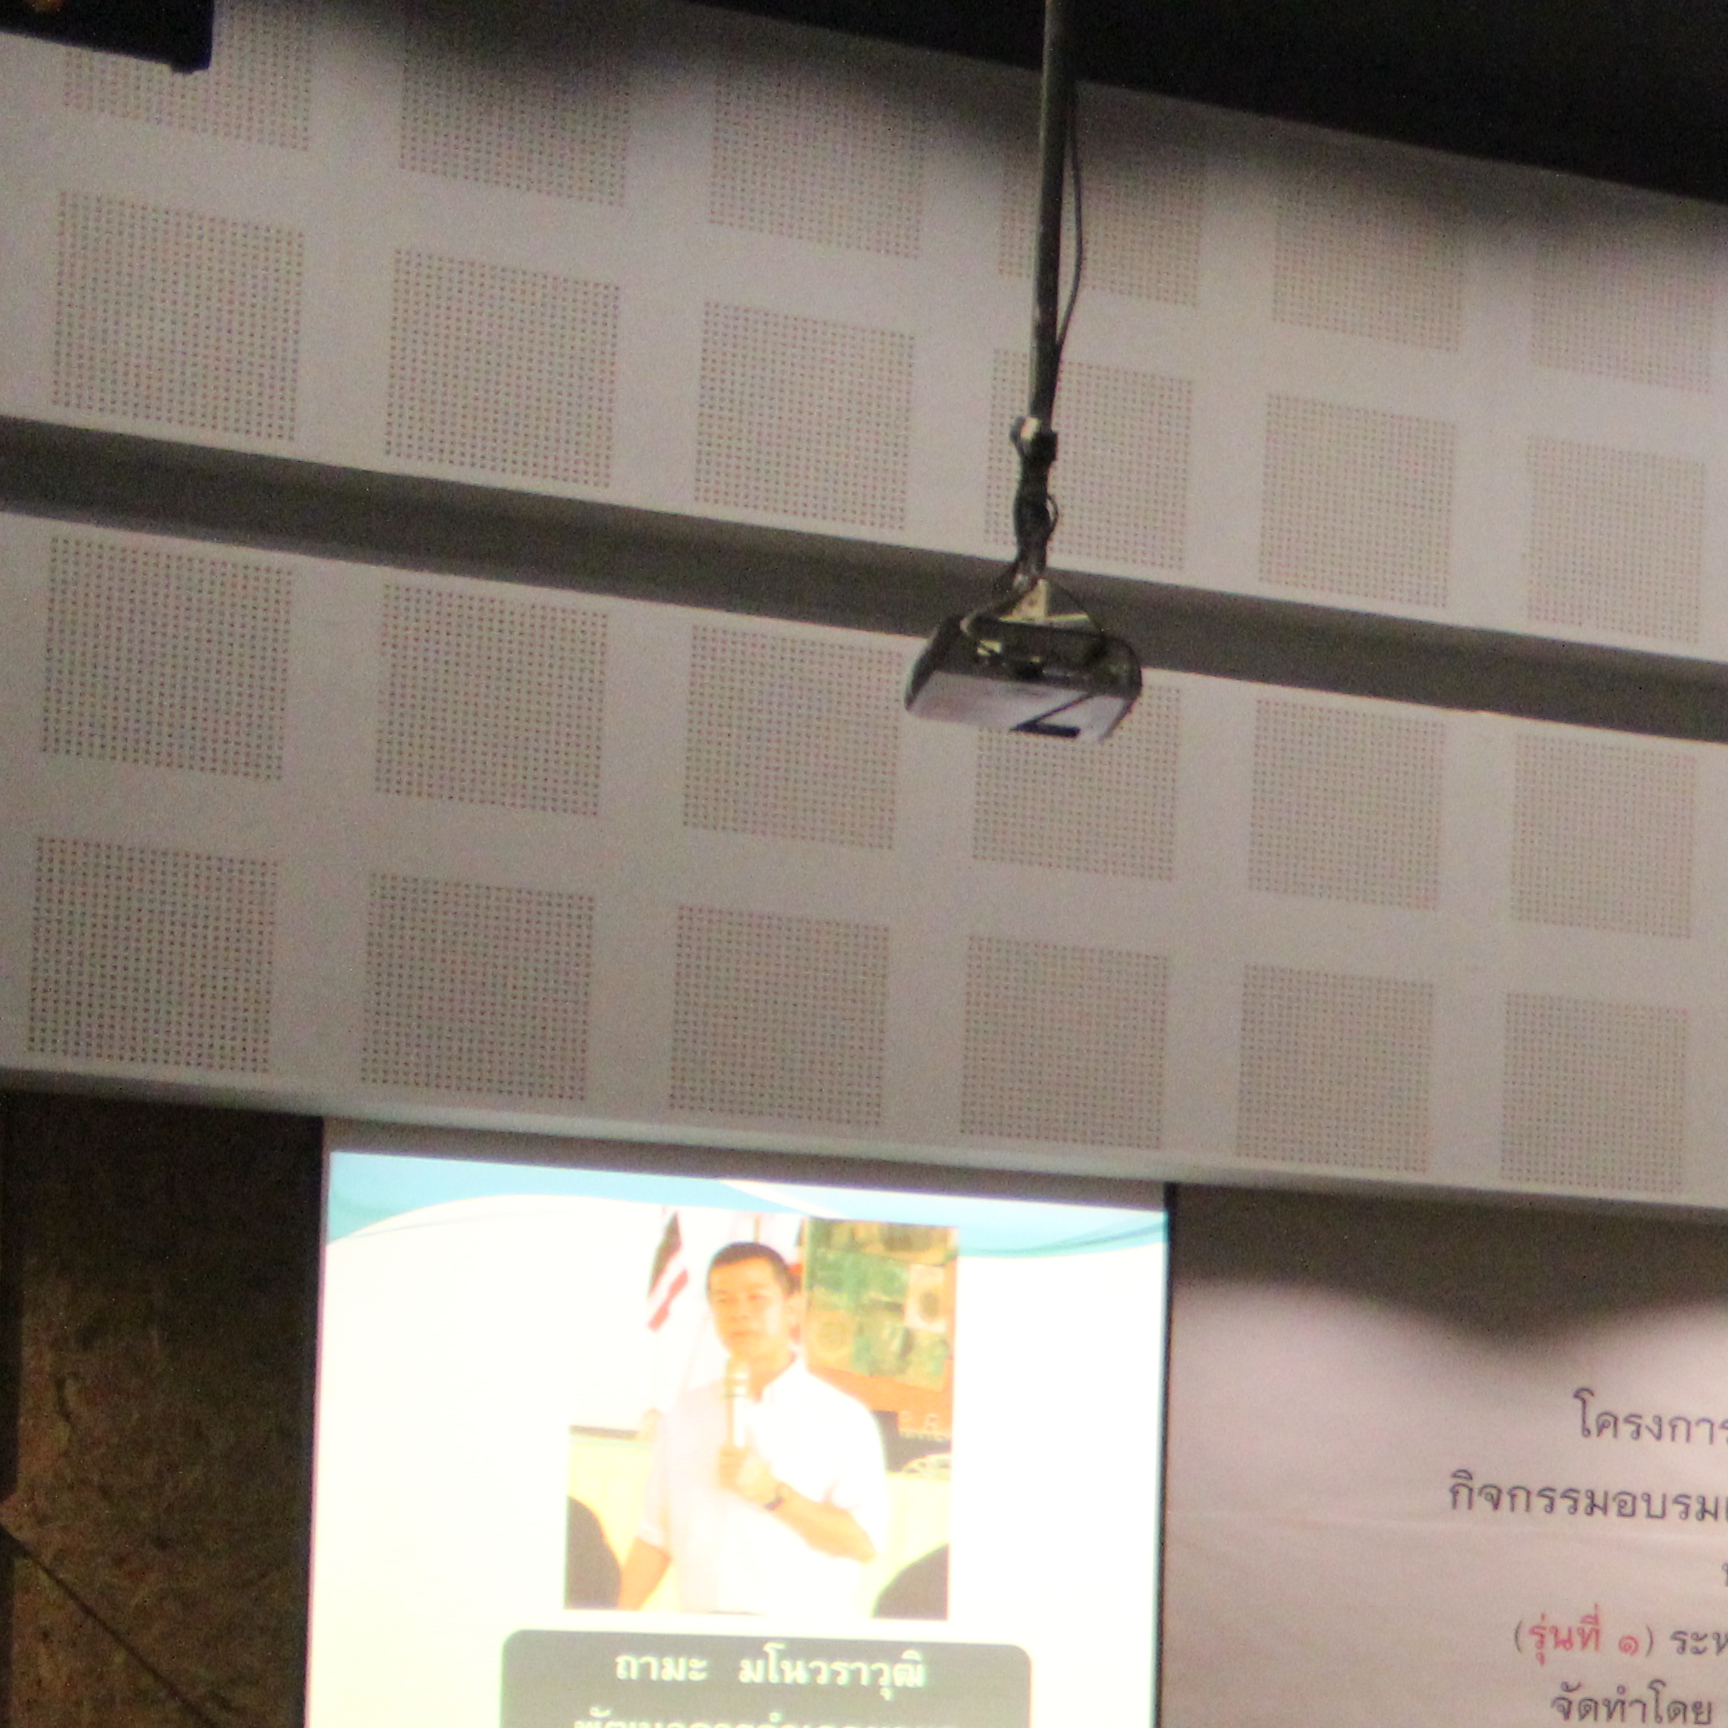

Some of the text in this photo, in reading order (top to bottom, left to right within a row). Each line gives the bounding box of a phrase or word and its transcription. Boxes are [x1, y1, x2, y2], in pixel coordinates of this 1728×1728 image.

[614, 1641, 929, 1701] ถามะ มโนวราวุฒิ
[1551, 1678, 1714, 1726] จัดทำโดย
